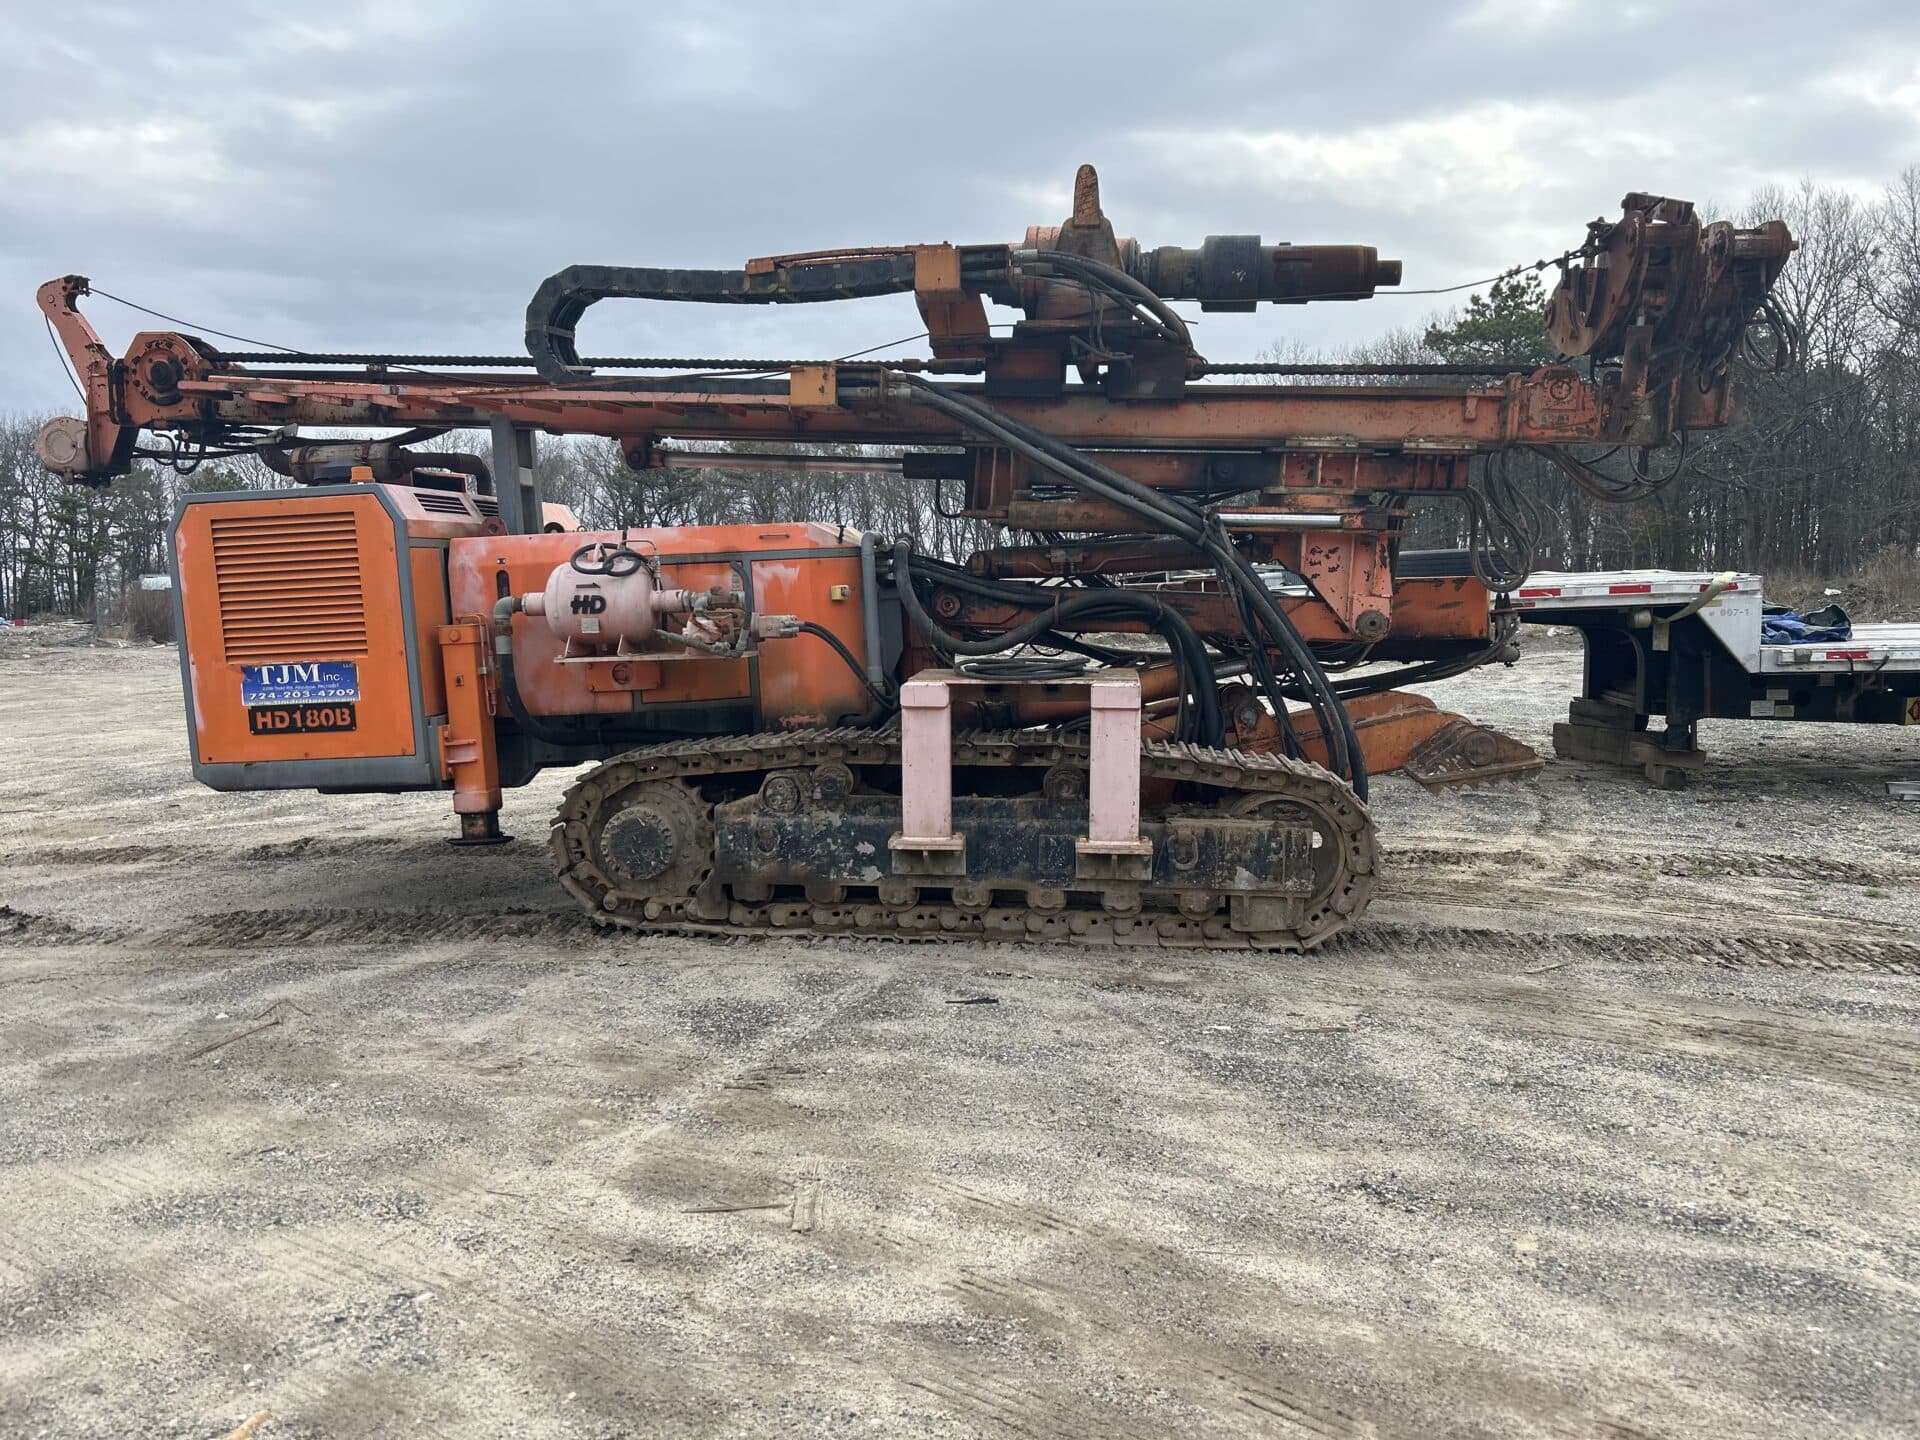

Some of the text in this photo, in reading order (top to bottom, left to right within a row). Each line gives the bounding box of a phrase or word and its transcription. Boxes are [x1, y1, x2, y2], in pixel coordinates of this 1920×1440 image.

[570, 595, 607, 615] HD
[254, 663, 344, 685] TJM inc.
[249, 688, 355, 700] 724-203-4709
[255, 708, 351, 730] HD180B
